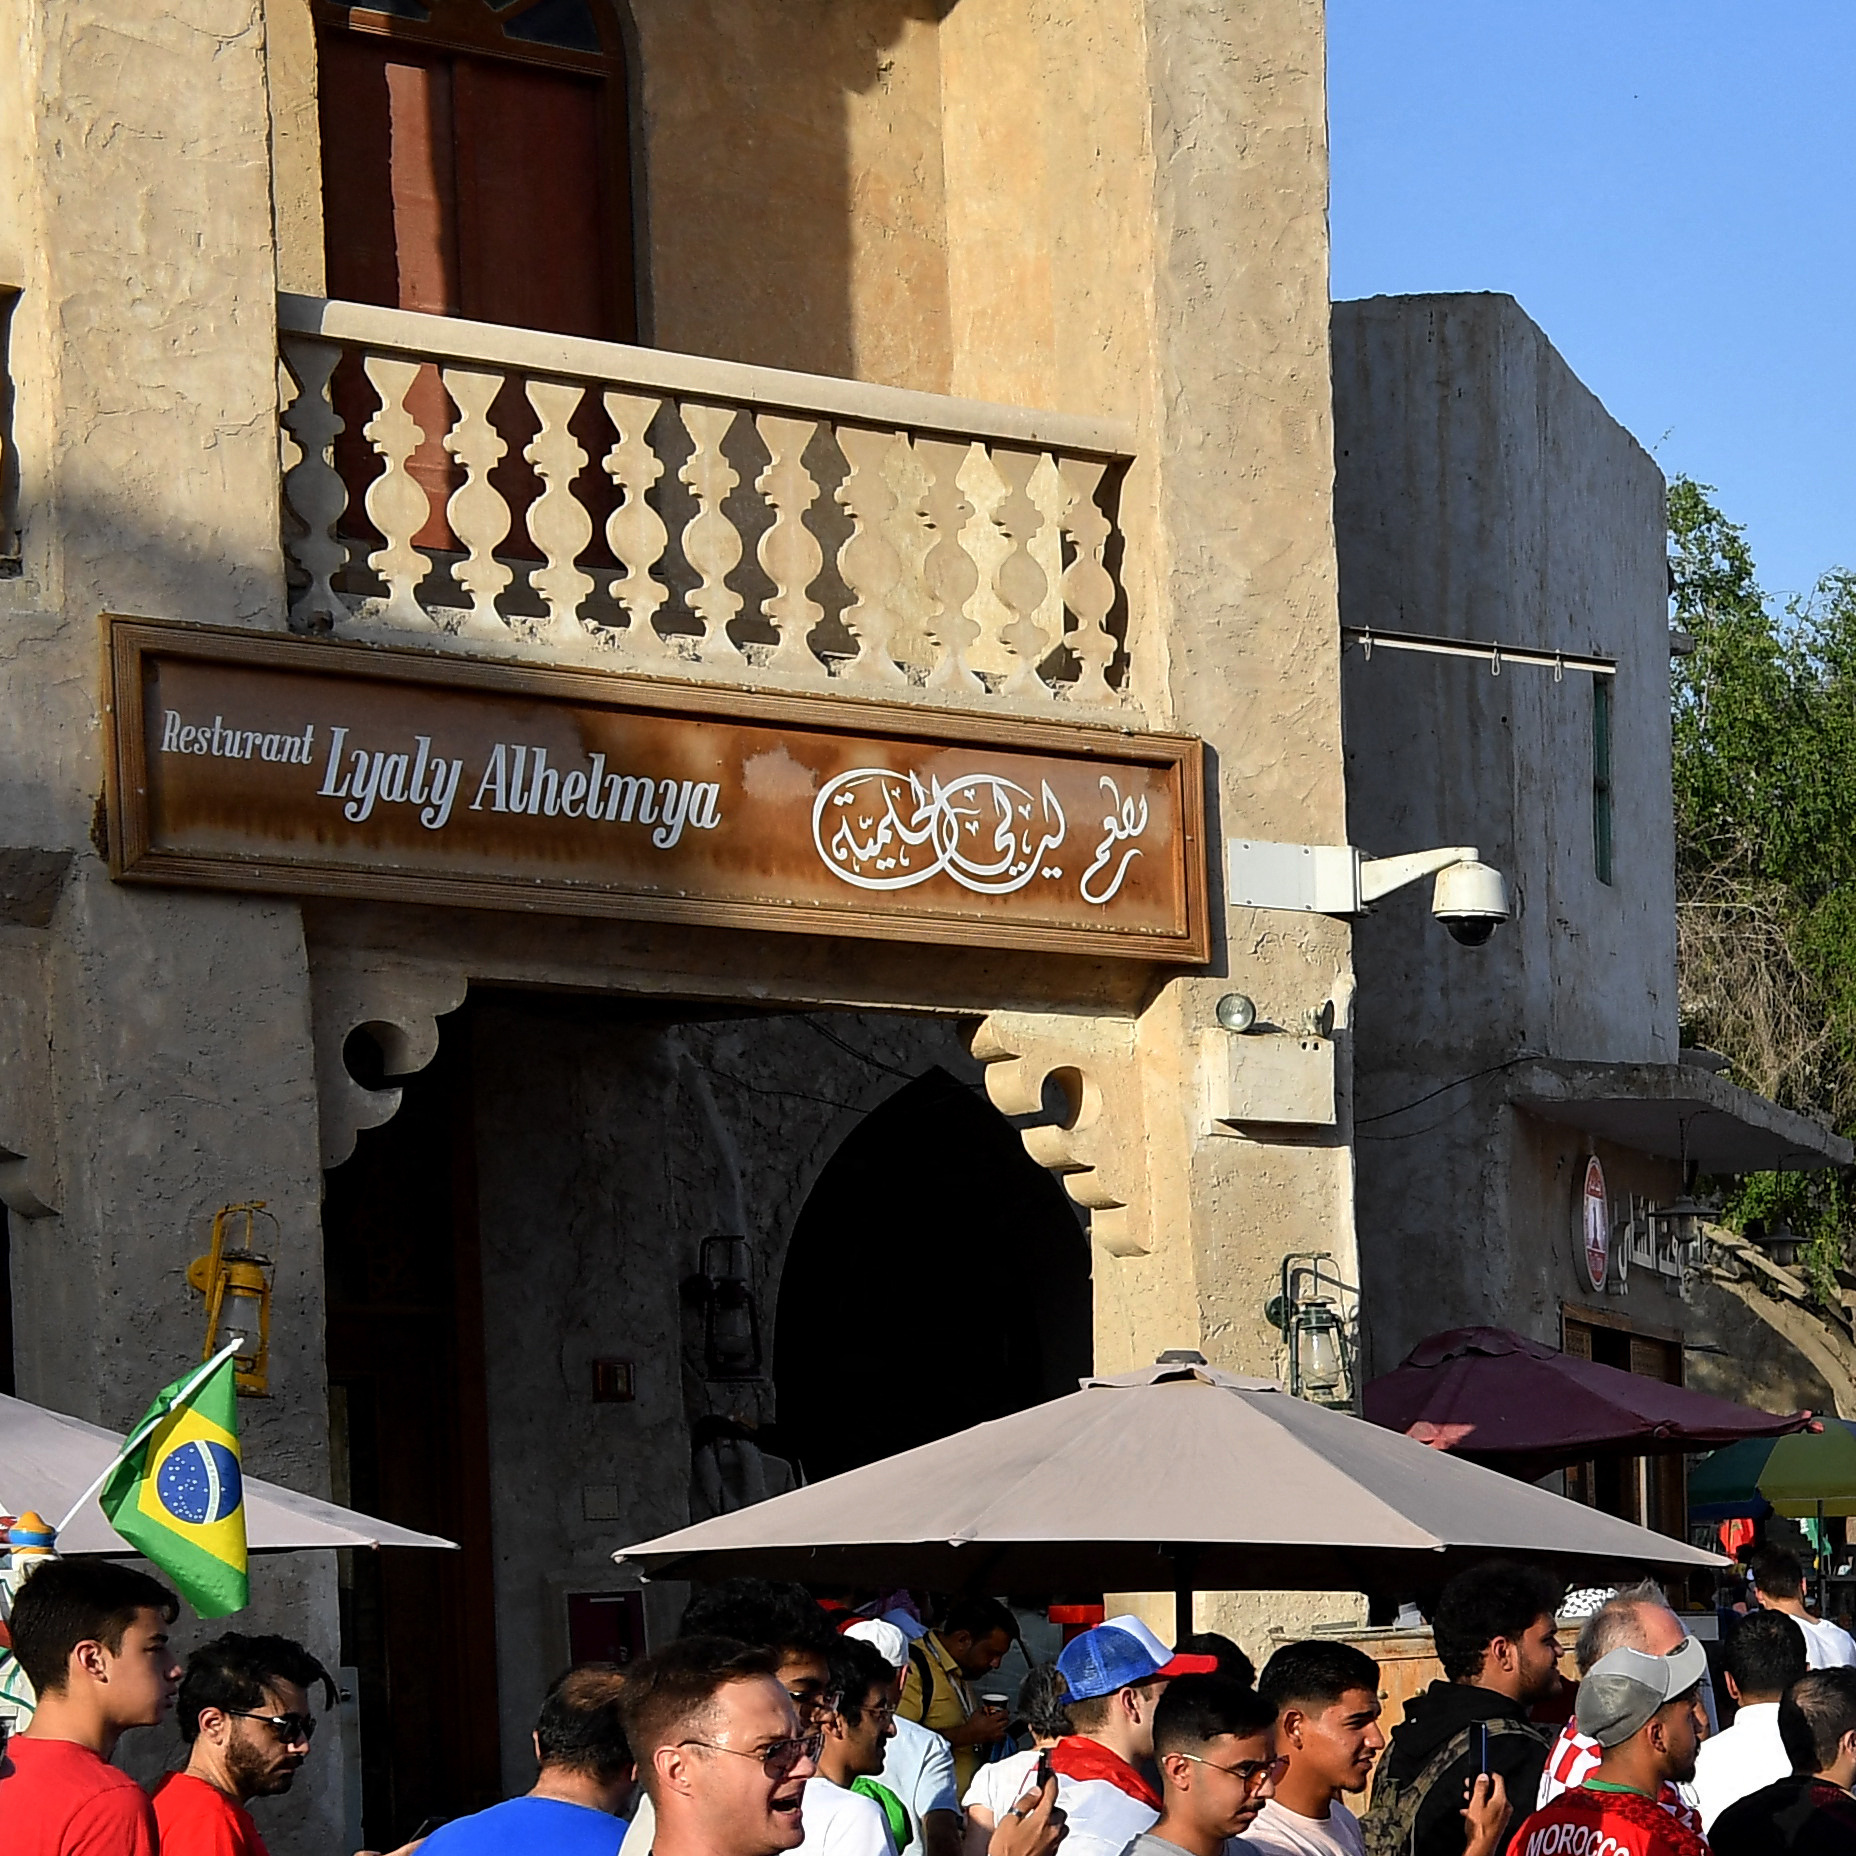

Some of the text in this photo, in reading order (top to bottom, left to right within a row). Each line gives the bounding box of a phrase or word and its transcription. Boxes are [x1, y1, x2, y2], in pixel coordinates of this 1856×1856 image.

[159, 709, 722, 850] Resturant Lyaly Alhelmya
